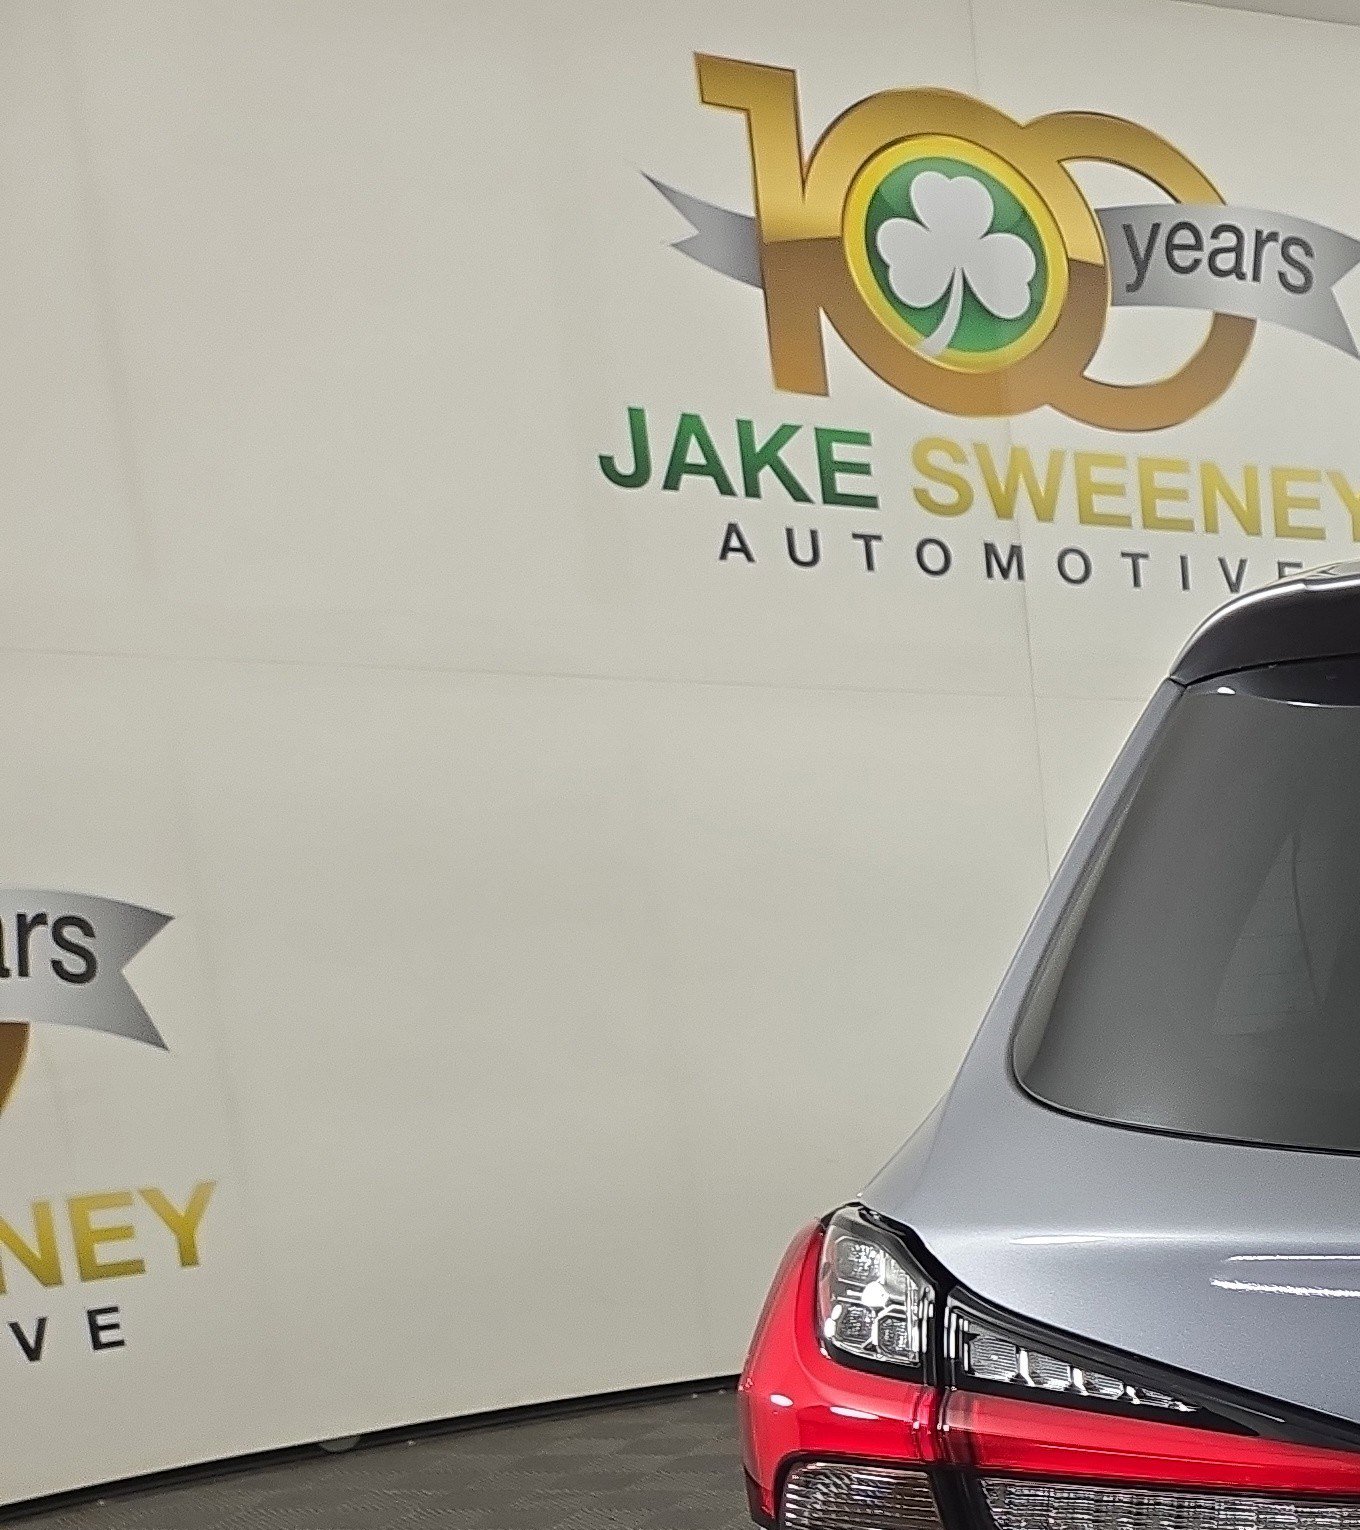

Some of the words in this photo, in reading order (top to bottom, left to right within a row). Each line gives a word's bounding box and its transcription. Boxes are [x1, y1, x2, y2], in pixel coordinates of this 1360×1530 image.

[694, 51, 1257, 433] 100
[1122, 220, 1315, 294] years
[599, 407, 880, 510] JAKE
